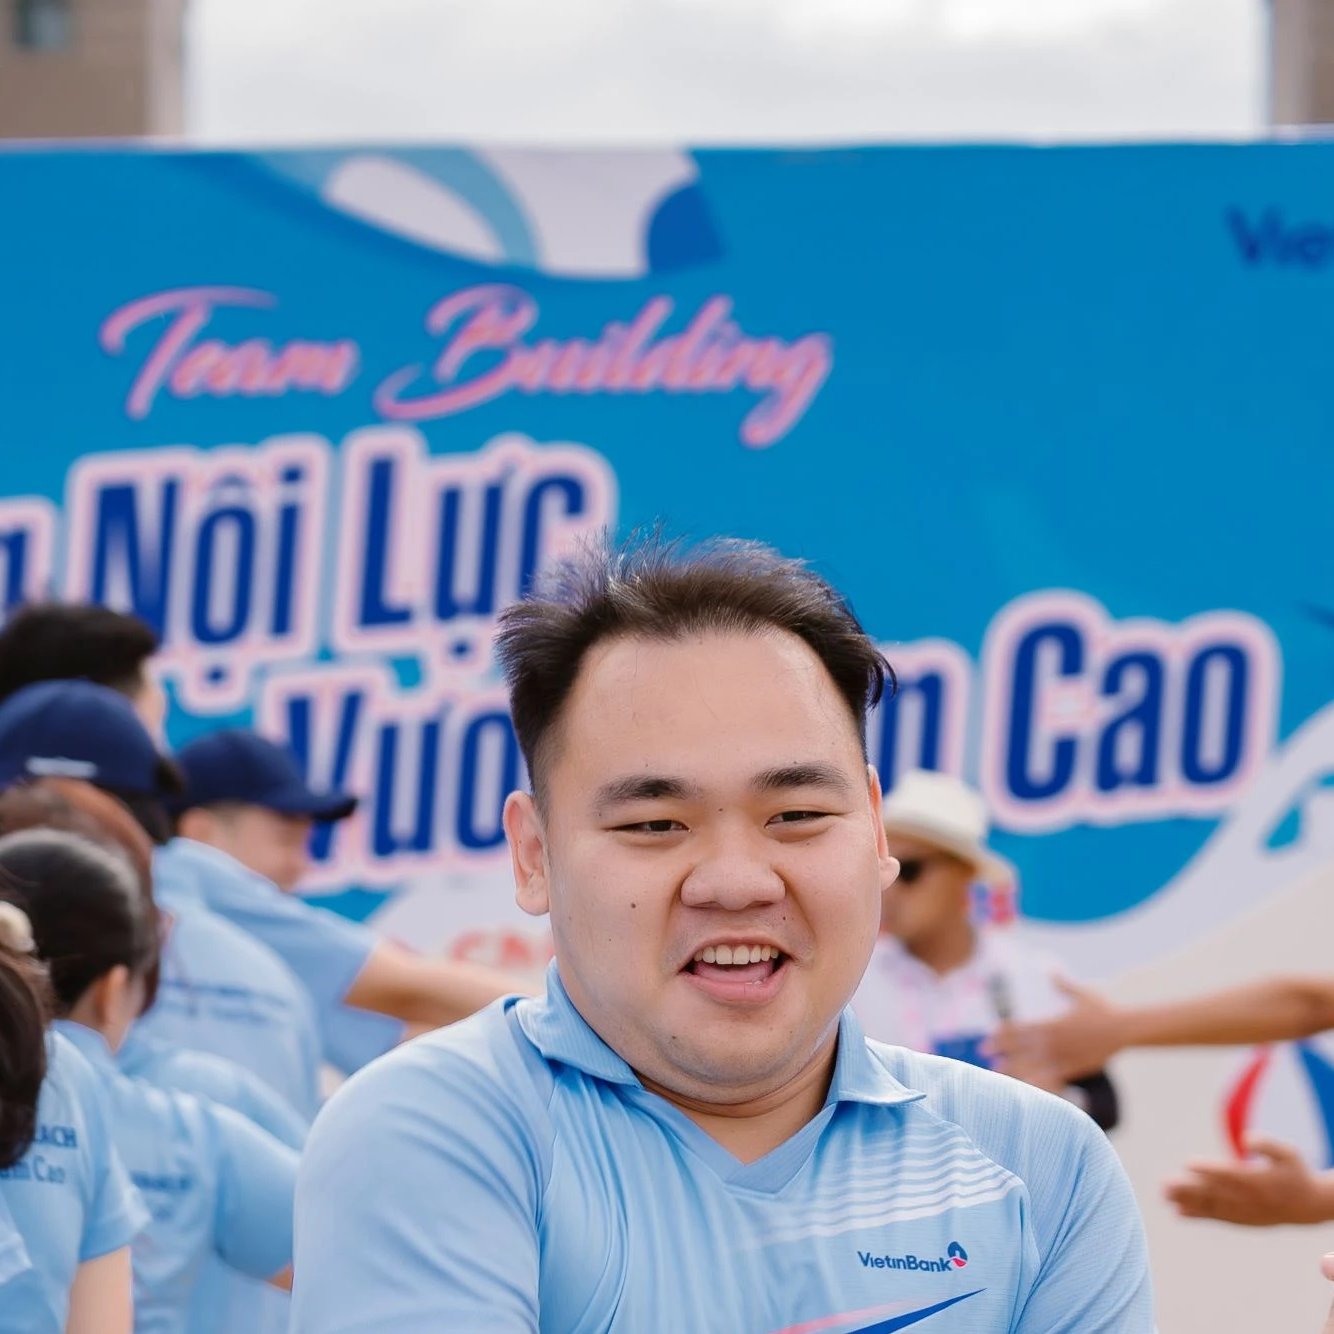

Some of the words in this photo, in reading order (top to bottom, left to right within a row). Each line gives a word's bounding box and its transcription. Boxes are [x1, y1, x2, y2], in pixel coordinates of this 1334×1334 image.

[97, 285, 361, 420] Team
[372, 283, 835, 450] Building
[1005, 620, 1251, 802] Cao
[857, 1250, 953, 1273] VietinBank
